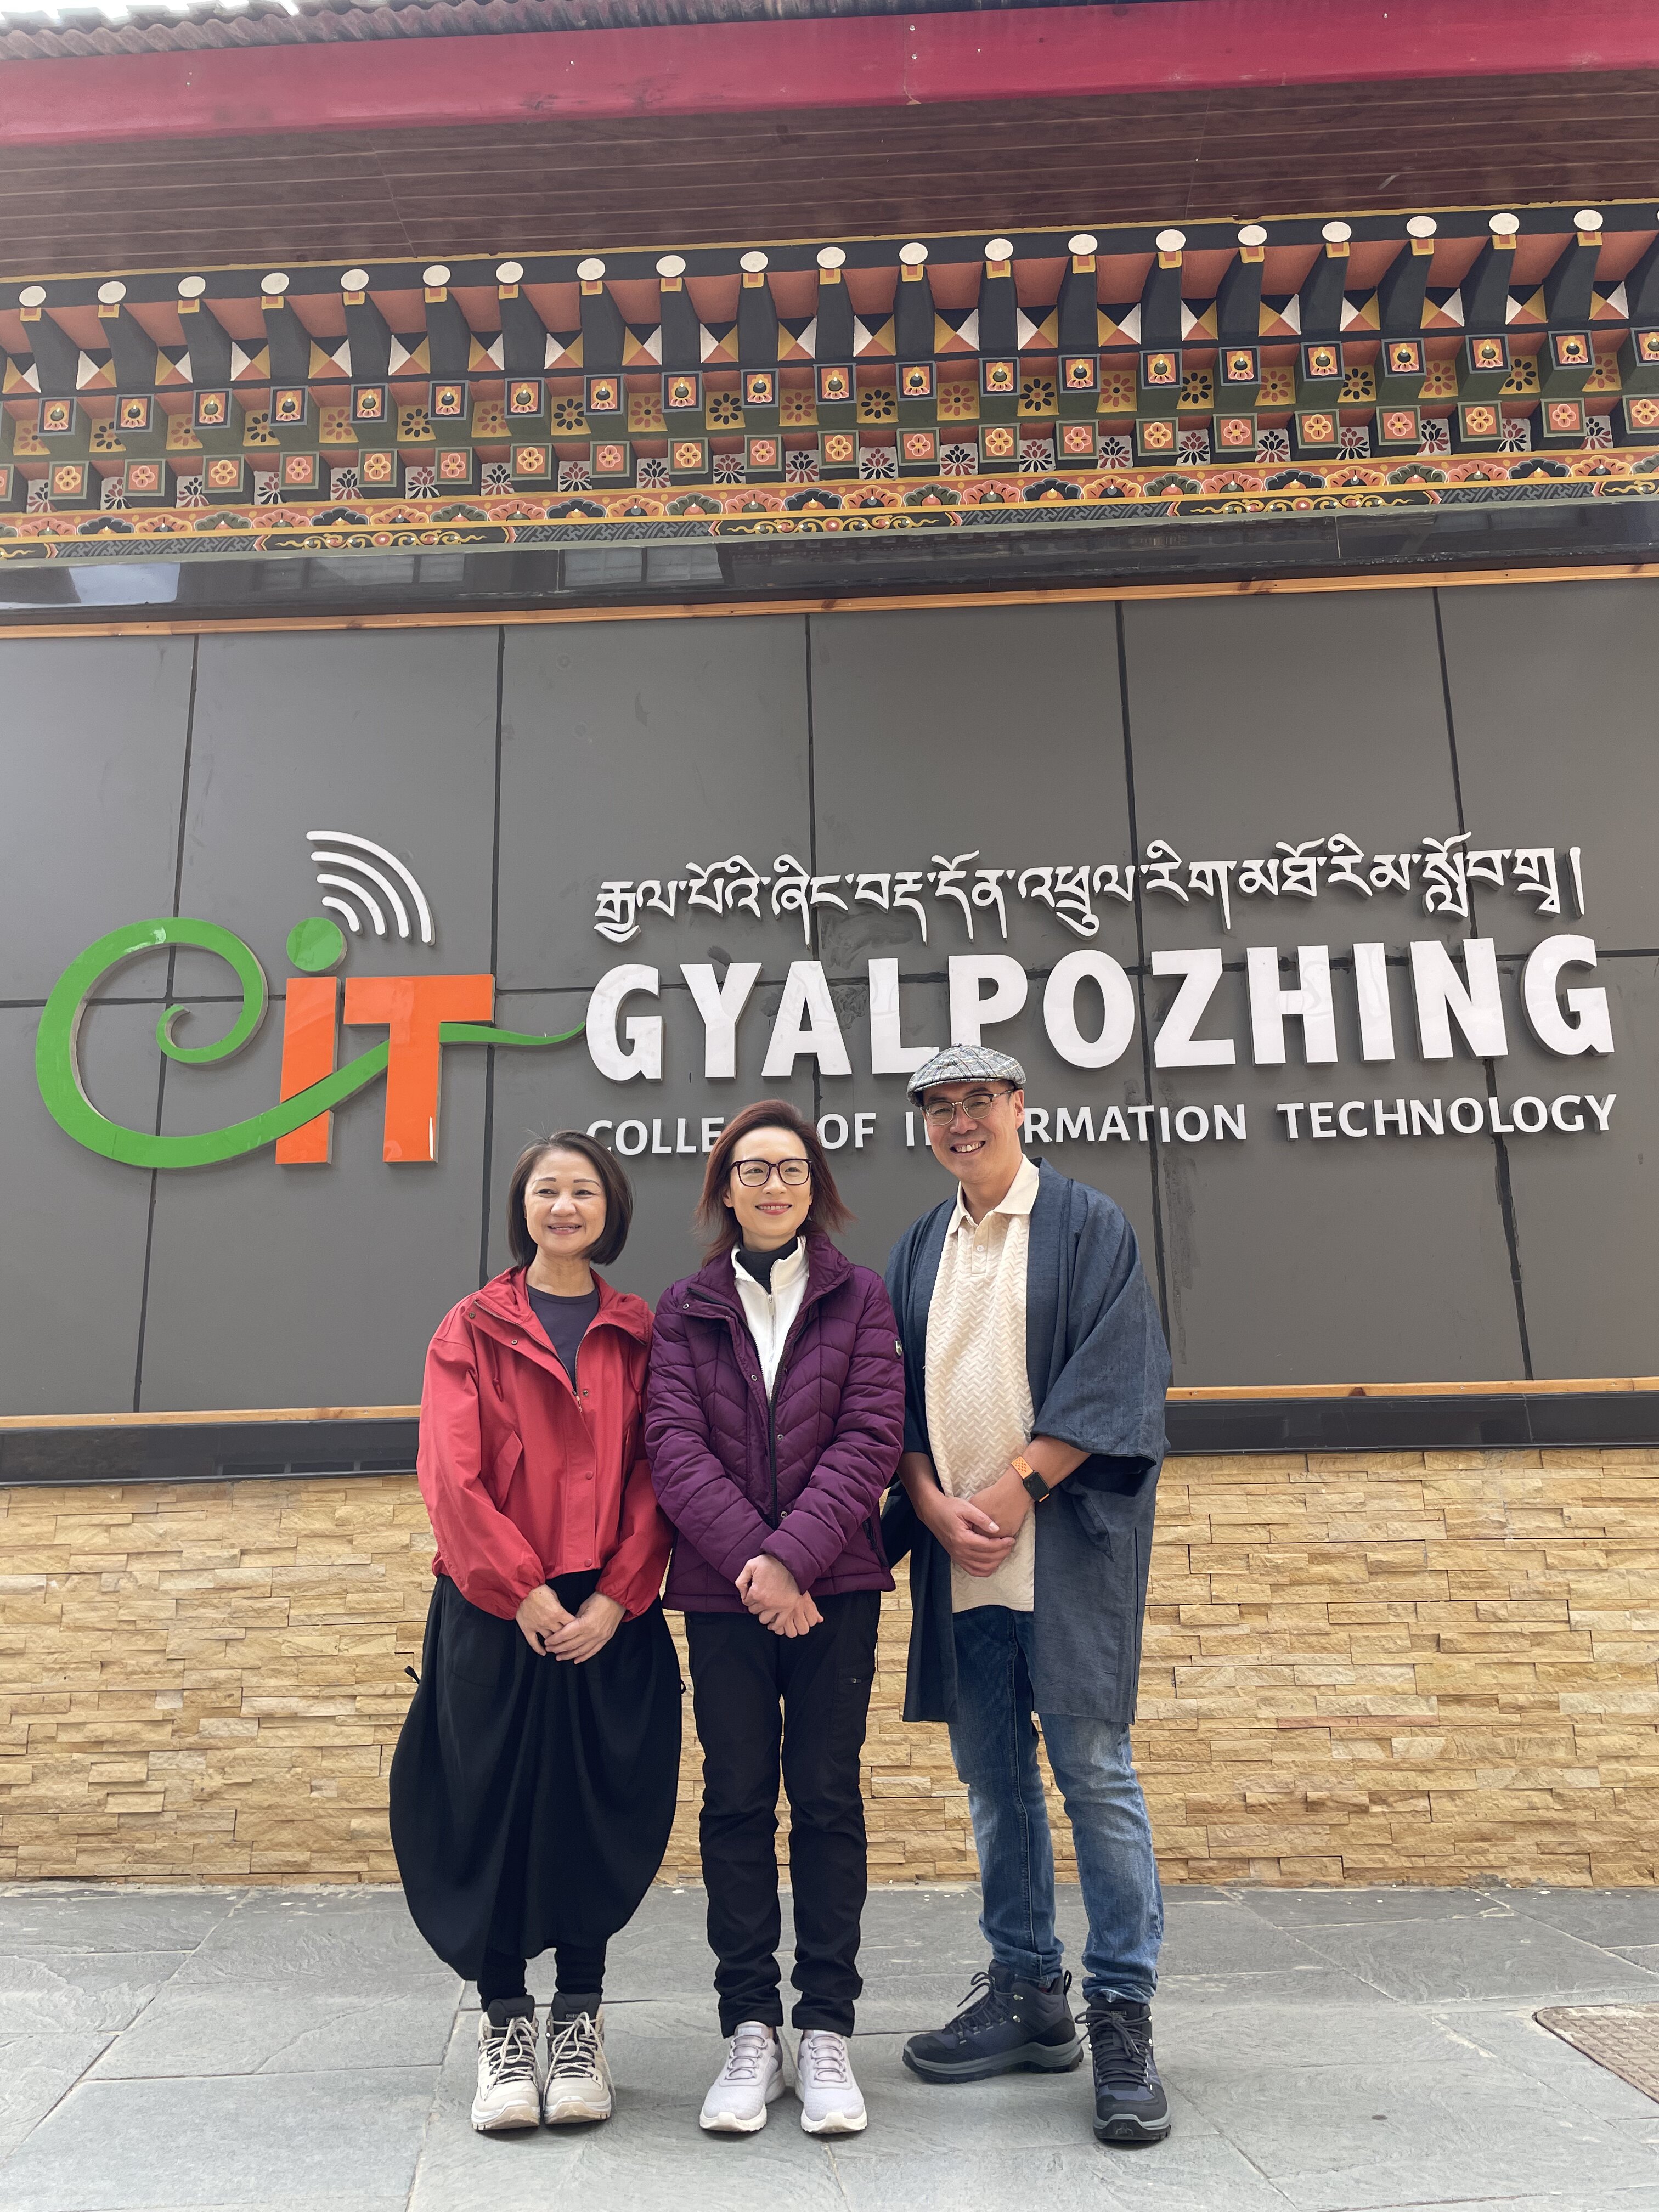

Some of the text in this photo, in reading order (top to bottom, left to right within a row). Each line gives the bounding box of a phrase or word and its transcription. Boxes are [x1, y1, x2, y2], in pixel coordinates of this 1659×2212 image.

[586, 934, 1615, 1082] GYALPOZHING
[586, 1094, 1617, 1155] COLLE OF IRMATION TECHNOLOGY
